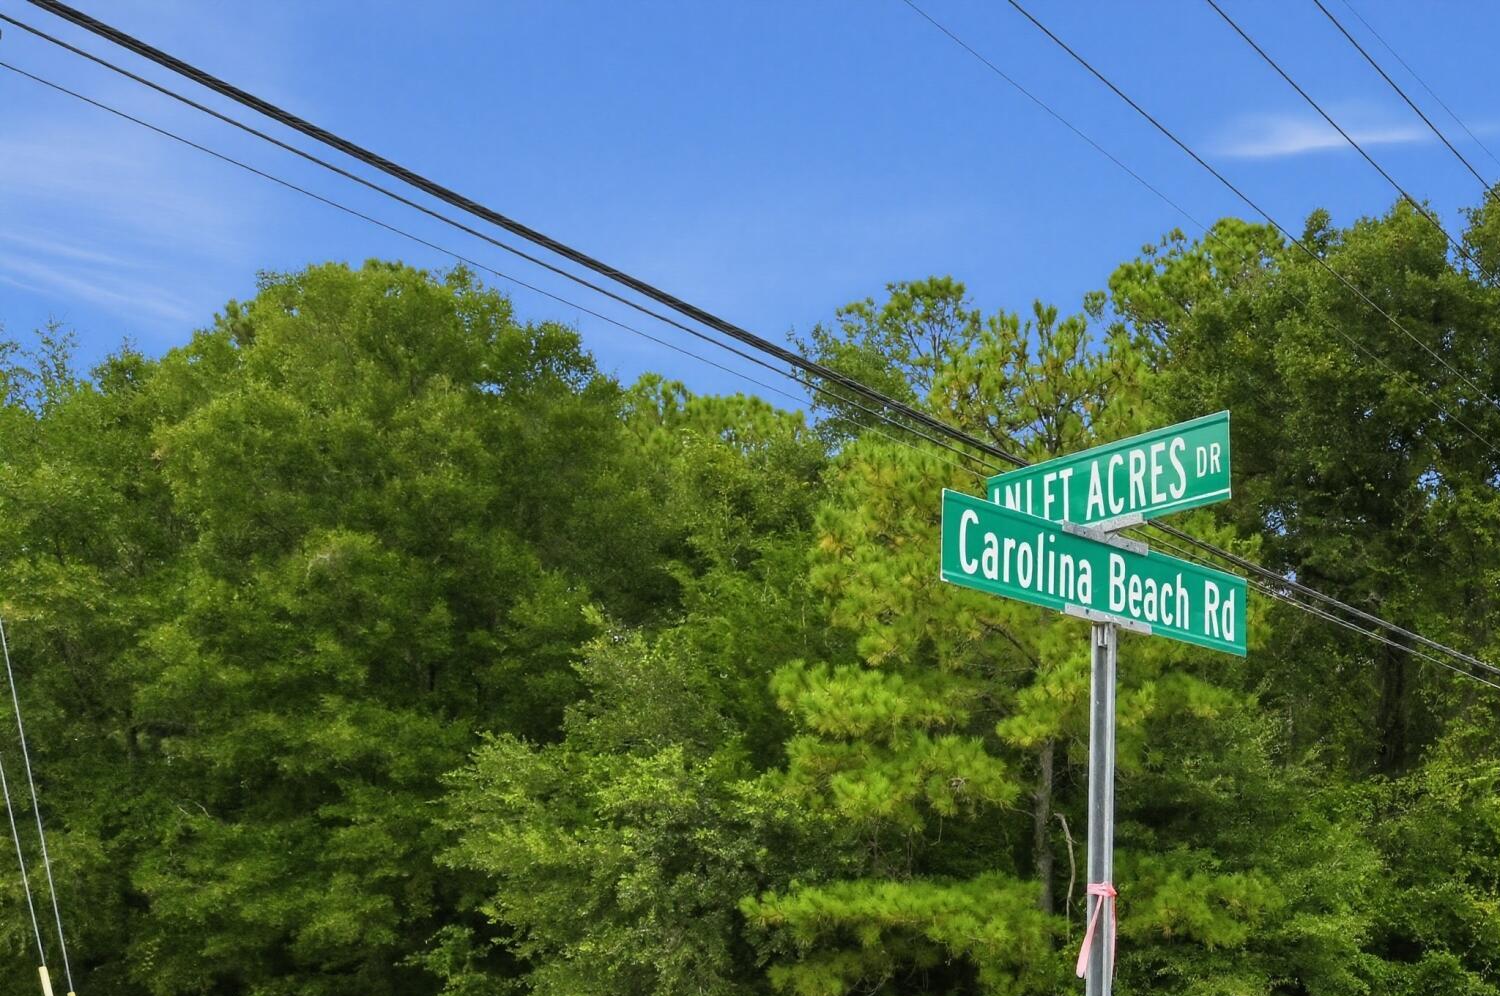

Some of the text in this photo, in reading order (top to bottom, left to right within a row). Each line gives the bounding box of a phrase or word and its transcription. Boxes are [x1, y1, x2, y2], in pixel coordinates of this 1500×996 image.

[1086, 437, 1187, 521] ACRES
[1196, 442, 1222, 478] DR
[959, 509, 1235, 642] Carolina Beach Rd
